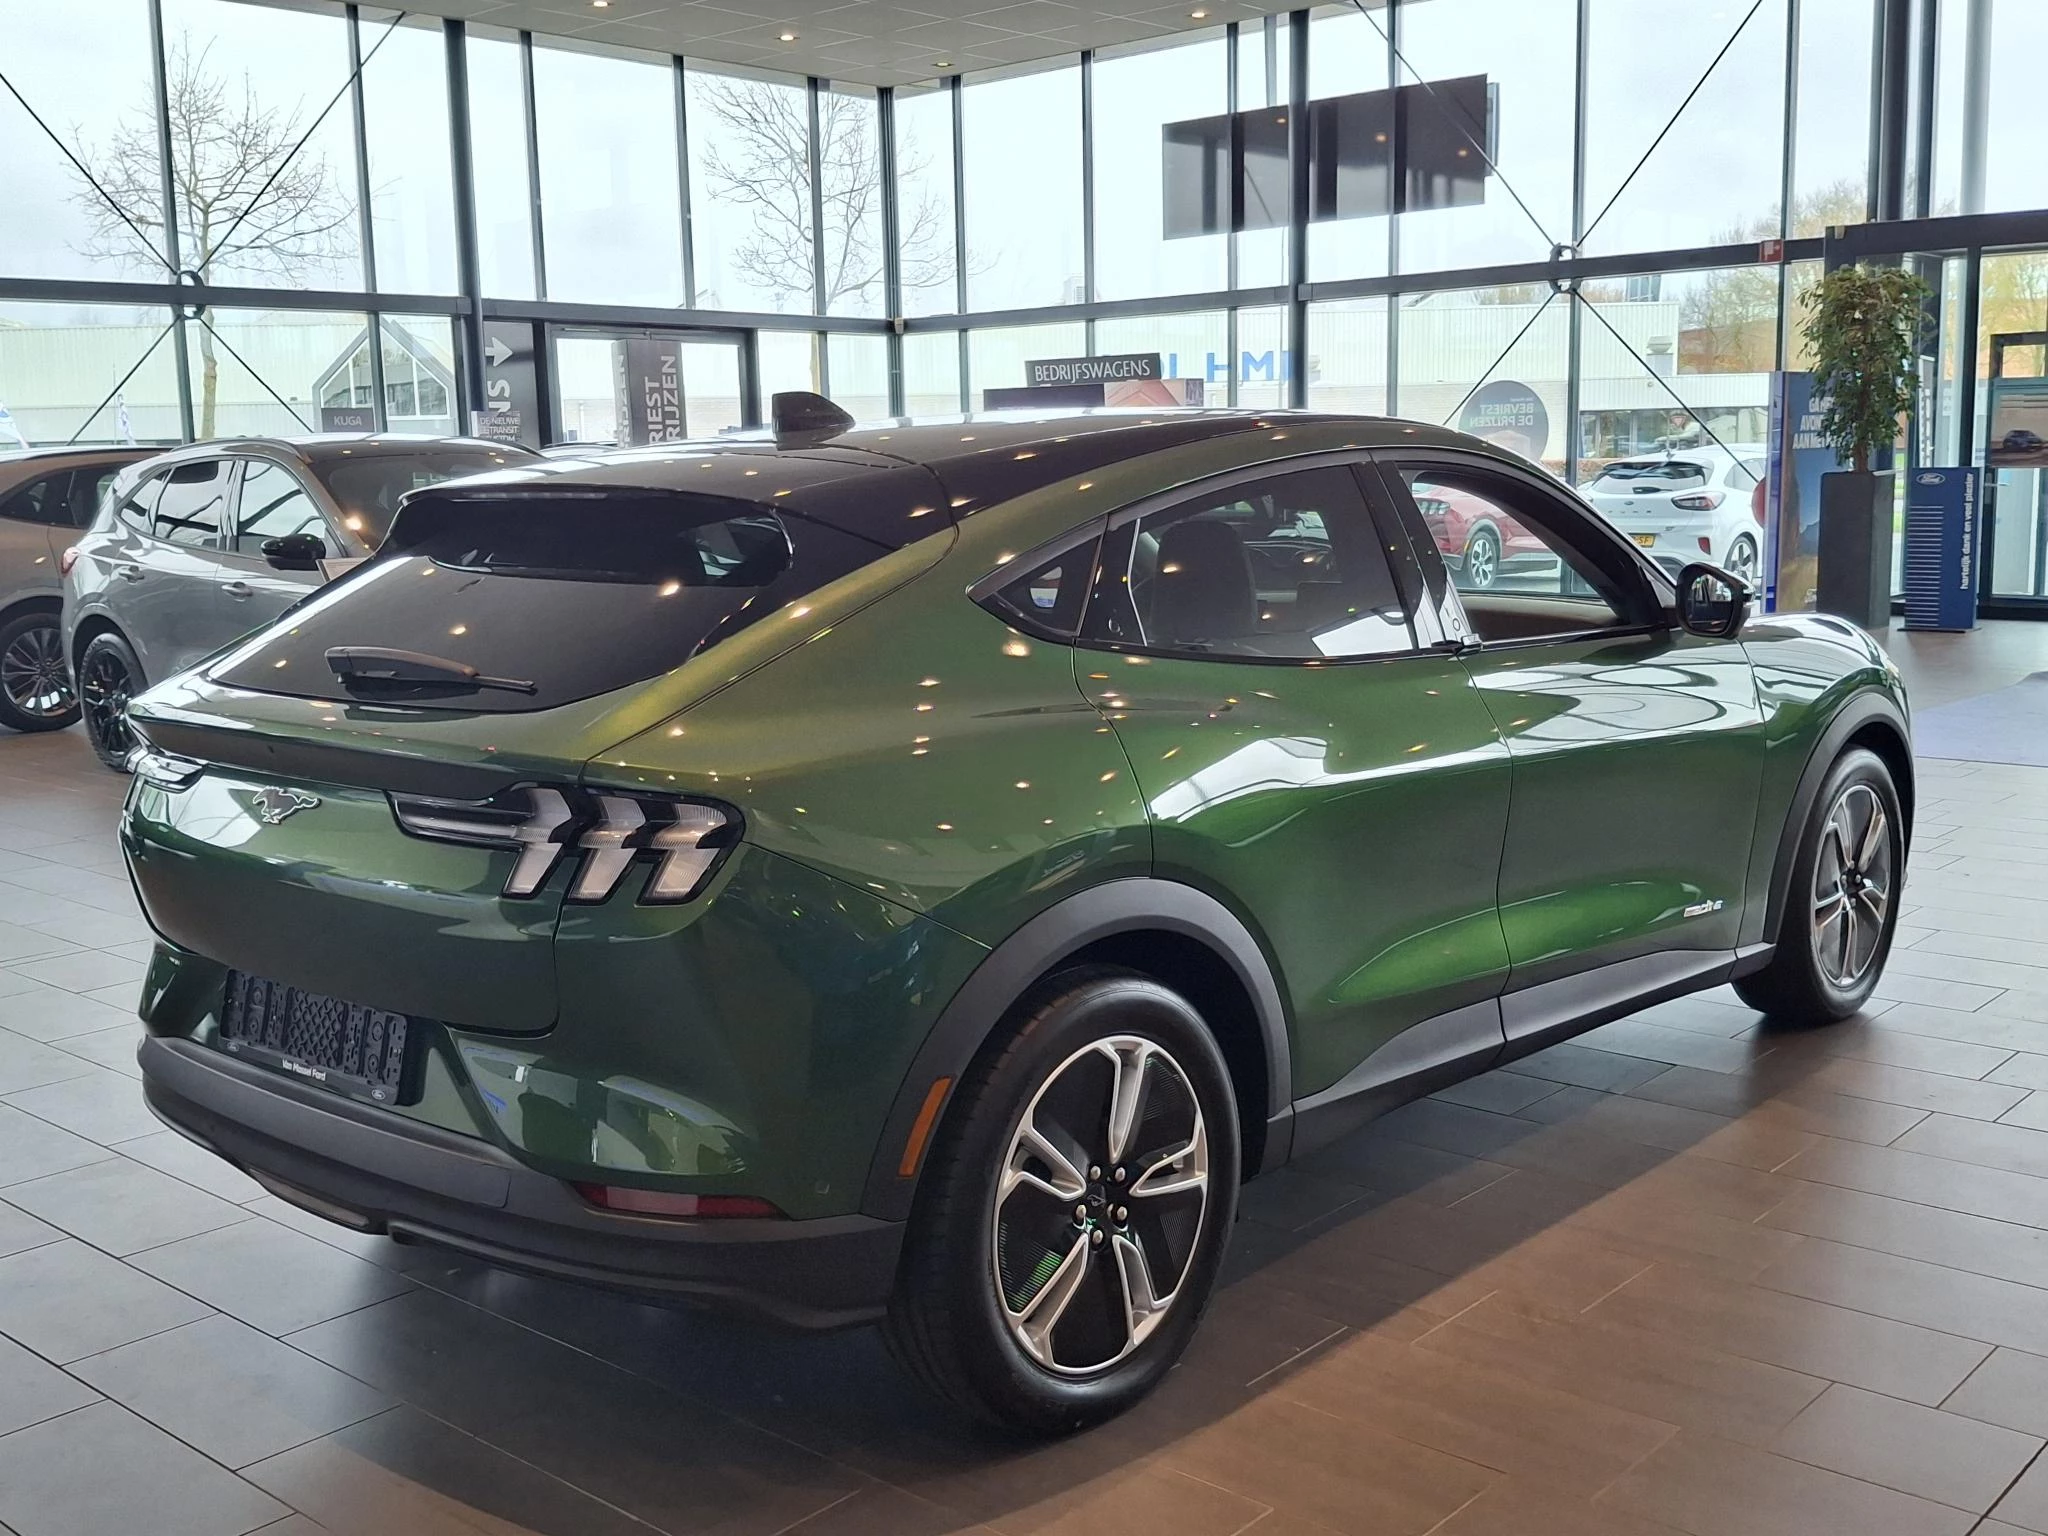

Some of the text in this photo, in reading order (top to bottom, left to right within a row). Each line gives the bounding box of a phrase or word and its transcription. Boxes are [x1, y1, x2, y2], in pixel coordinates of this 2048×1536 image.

[1034, 359, 1151, 384] BEDRIJFSWAGENS
[333, 415, 363, 426] KUGA
[644, 376, 664, 444] RIEST
[661, 355, 681, 440] RIJZEN
